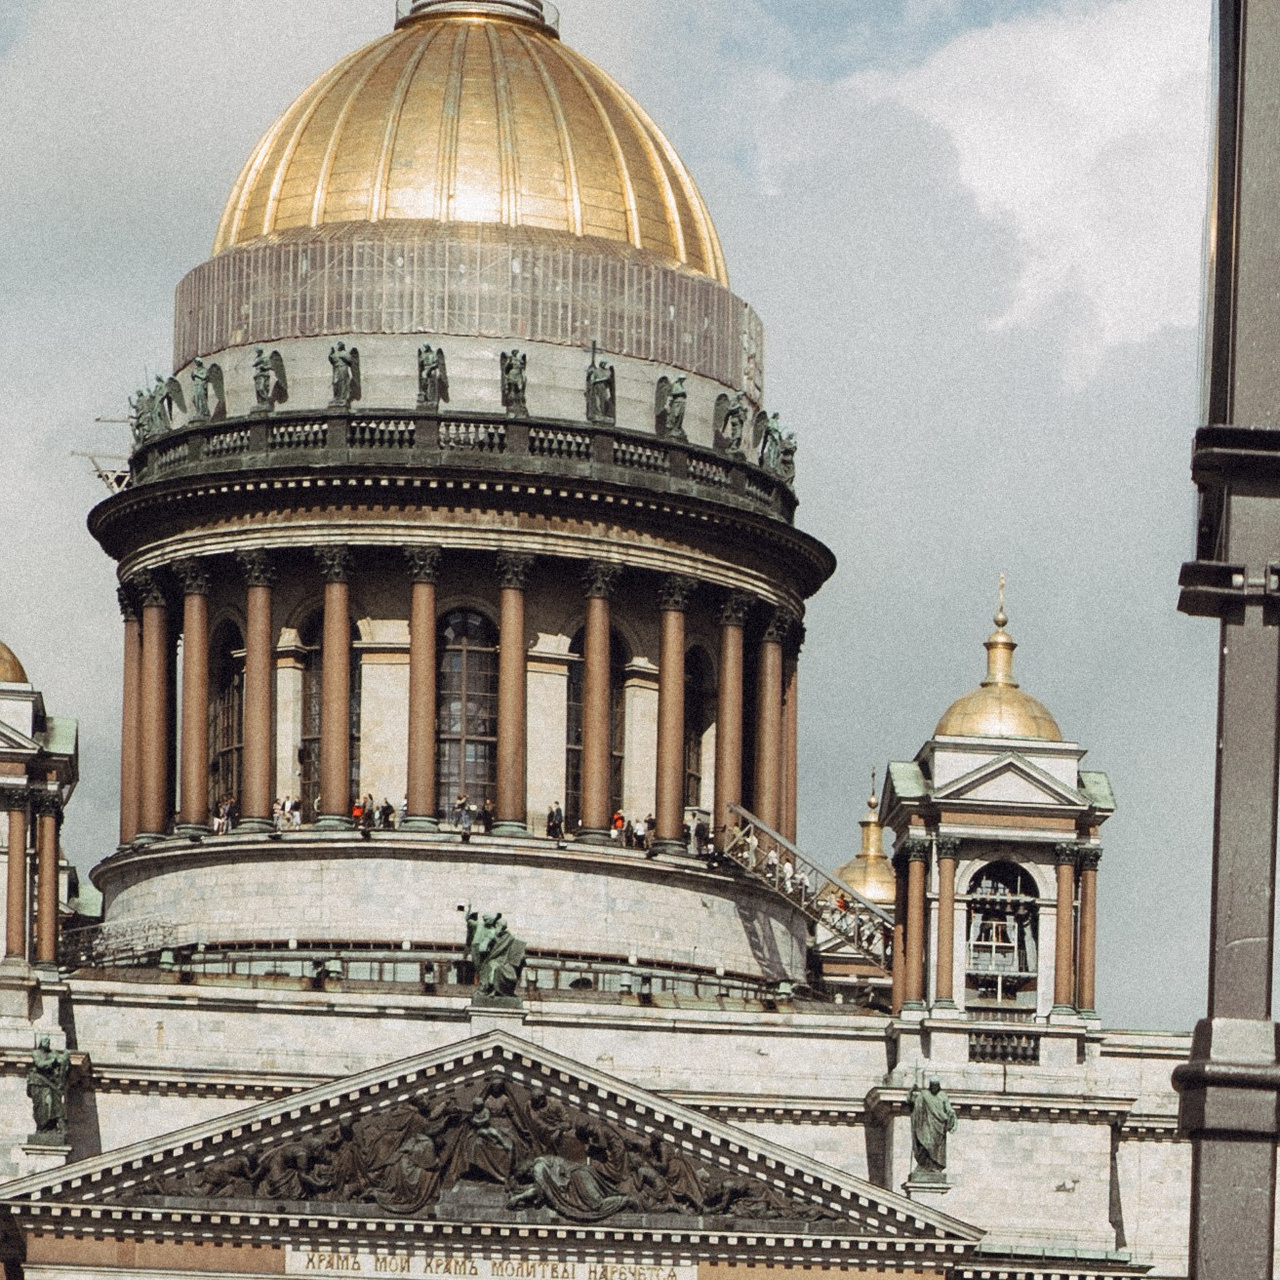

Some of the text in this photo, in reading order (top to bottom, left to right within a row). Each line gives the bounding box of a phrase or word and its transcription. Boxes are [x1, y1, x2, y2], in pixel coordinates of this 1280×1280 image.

[305, 1253, 361, 1271] ХРАМЪ
[423, 1256, 478, 1276] ХРАМЪ
[491, 1260, 576, 1279] МОЛИТВЫ
